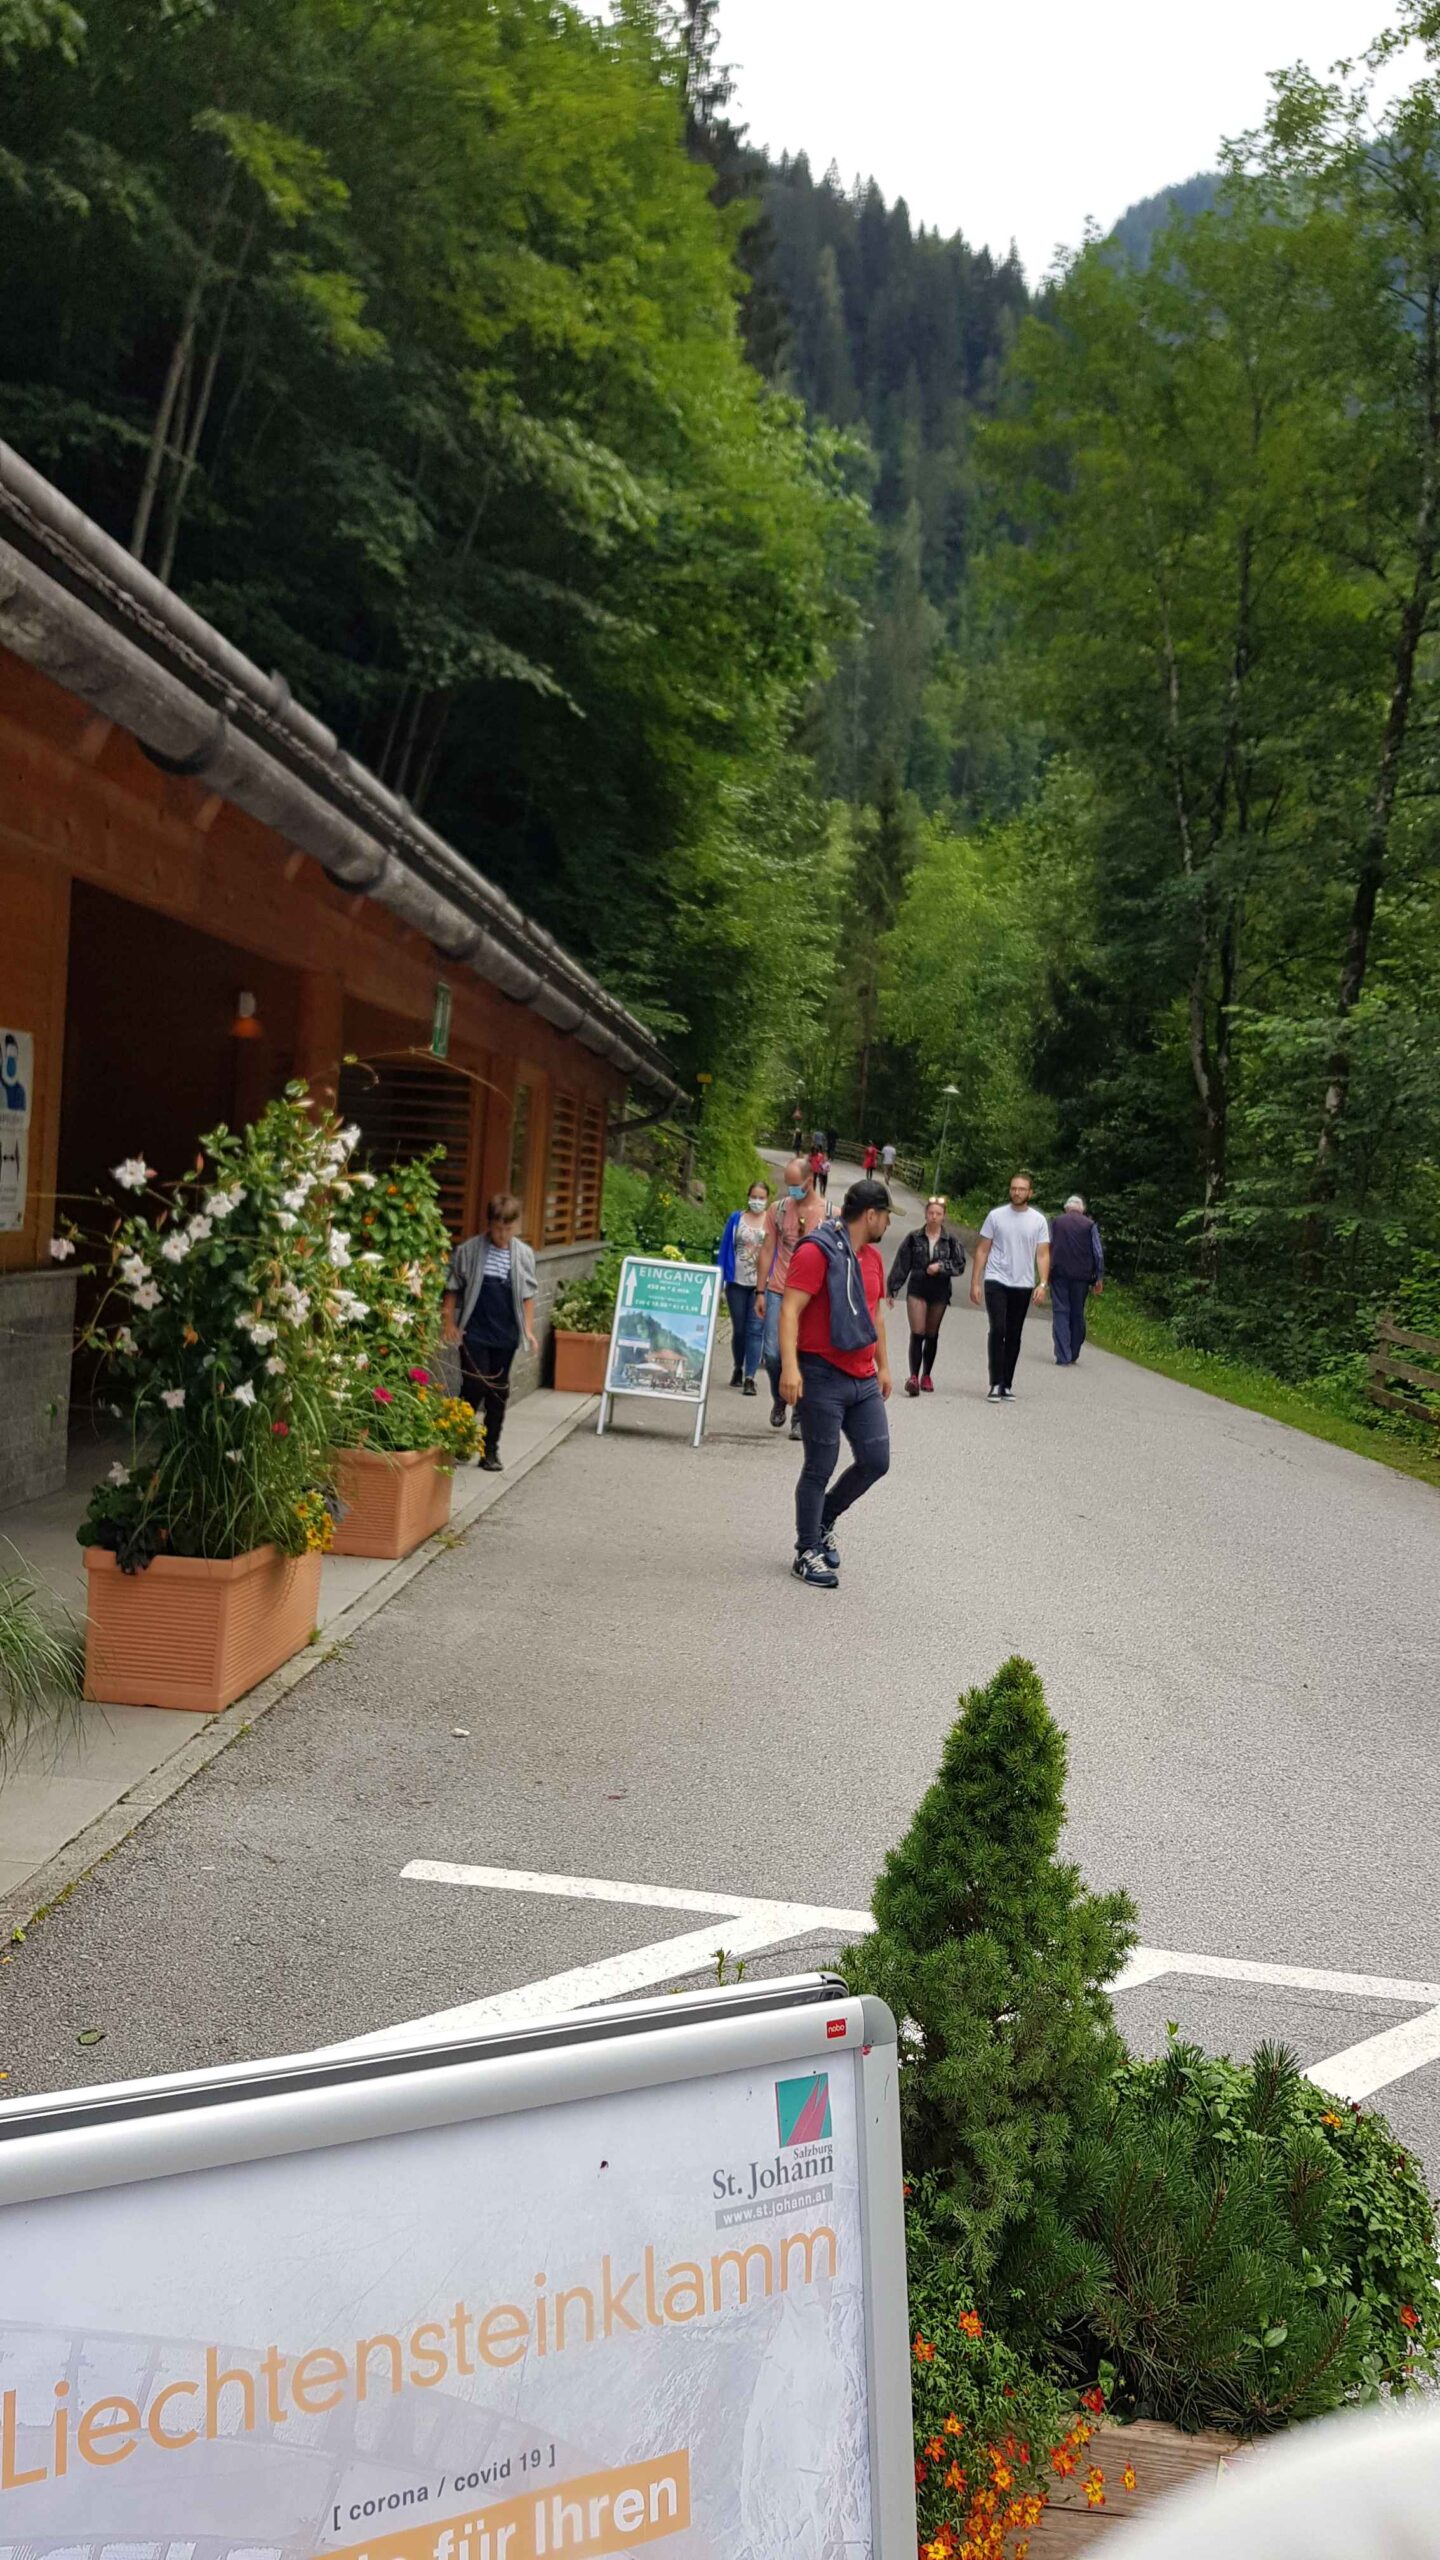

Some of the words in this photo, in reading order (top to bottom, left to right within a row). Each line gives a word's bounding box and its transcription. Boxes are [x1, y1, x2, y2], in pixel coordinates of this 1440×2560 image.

[639, 1266, 704, 1284] EINGANG
[828, 2023, 845, 2034] nobo
[793, 2143, 833, 2160] Salzburg
[712, 2169, 743, 2199] St.
[747, 2155, 834, 2199] Johann
[722, 2189, 827, 2225] www.st.johann.at
[2, 2226, 838, 2489] Liechtensteinklamm
[349, 2484, 429, 2521] corona
[454, 2458, 512, 2492] covid
[519, 2449, 541, 2473] 19
[433, 2519, 516, 2560] für
[535, 2475, 677, 2555] Ihren
